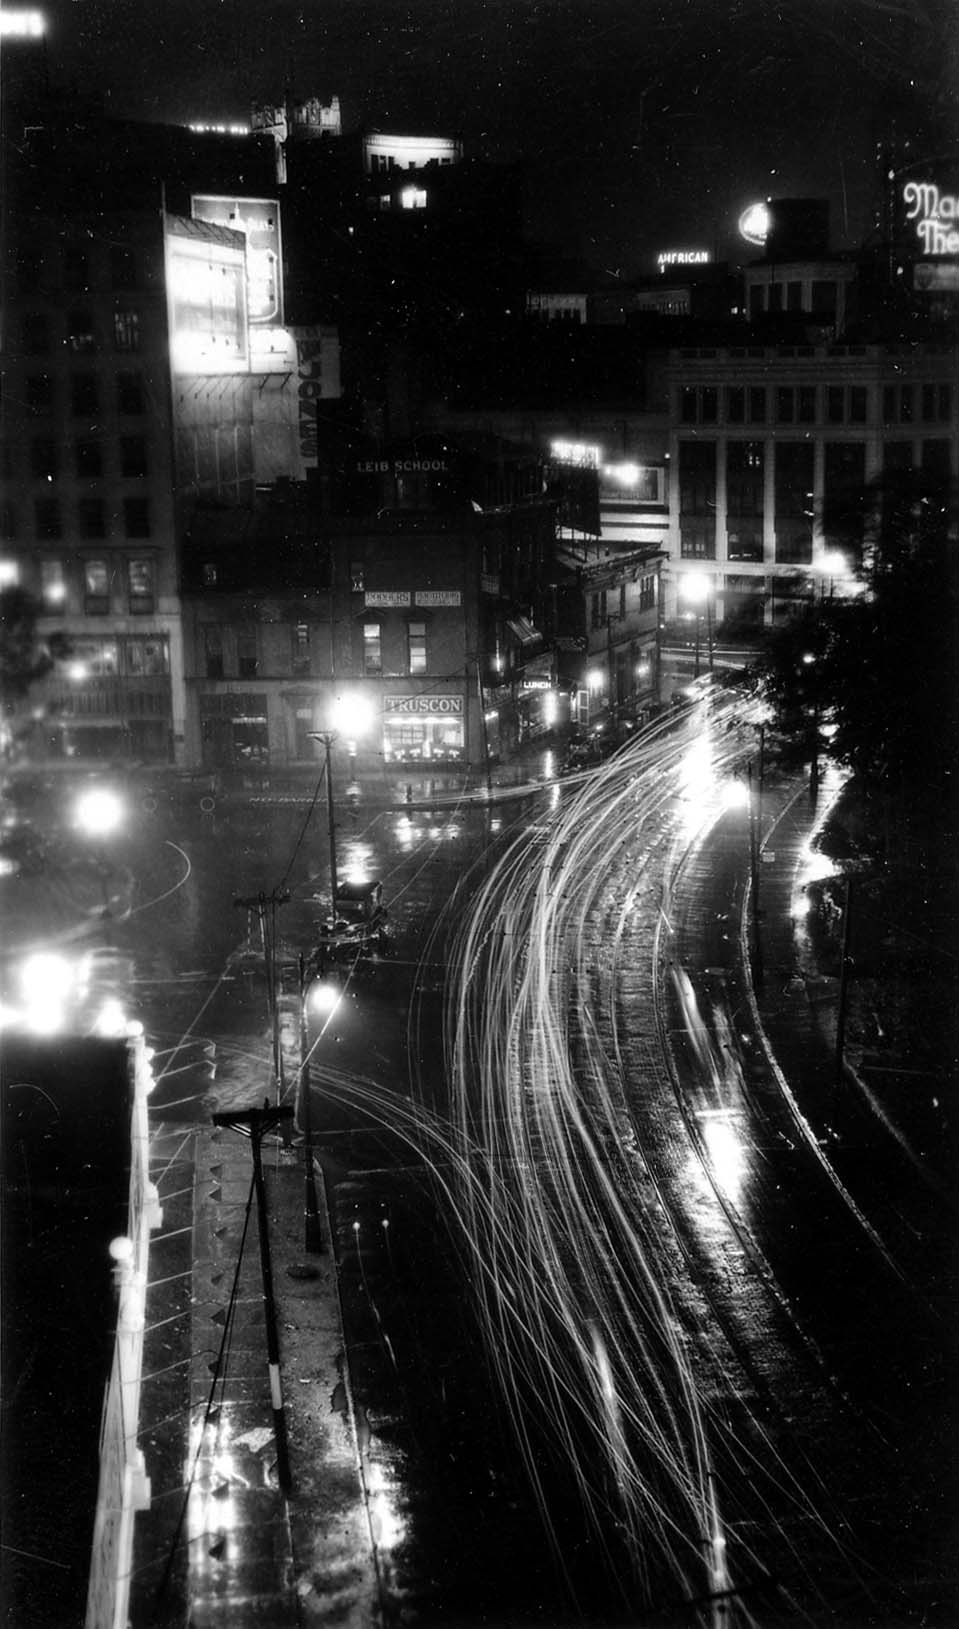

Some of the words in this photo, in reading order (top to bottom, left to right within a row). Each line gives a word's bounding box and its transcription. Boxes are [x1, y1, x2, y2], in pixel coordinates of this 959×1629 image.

[904, 182, 959, 219] Ma
[357, 461, 389, 472] LEIB
[394, 459, 448, 472] SCHOOL
[387, 699, 461, 712] TRUSCON
